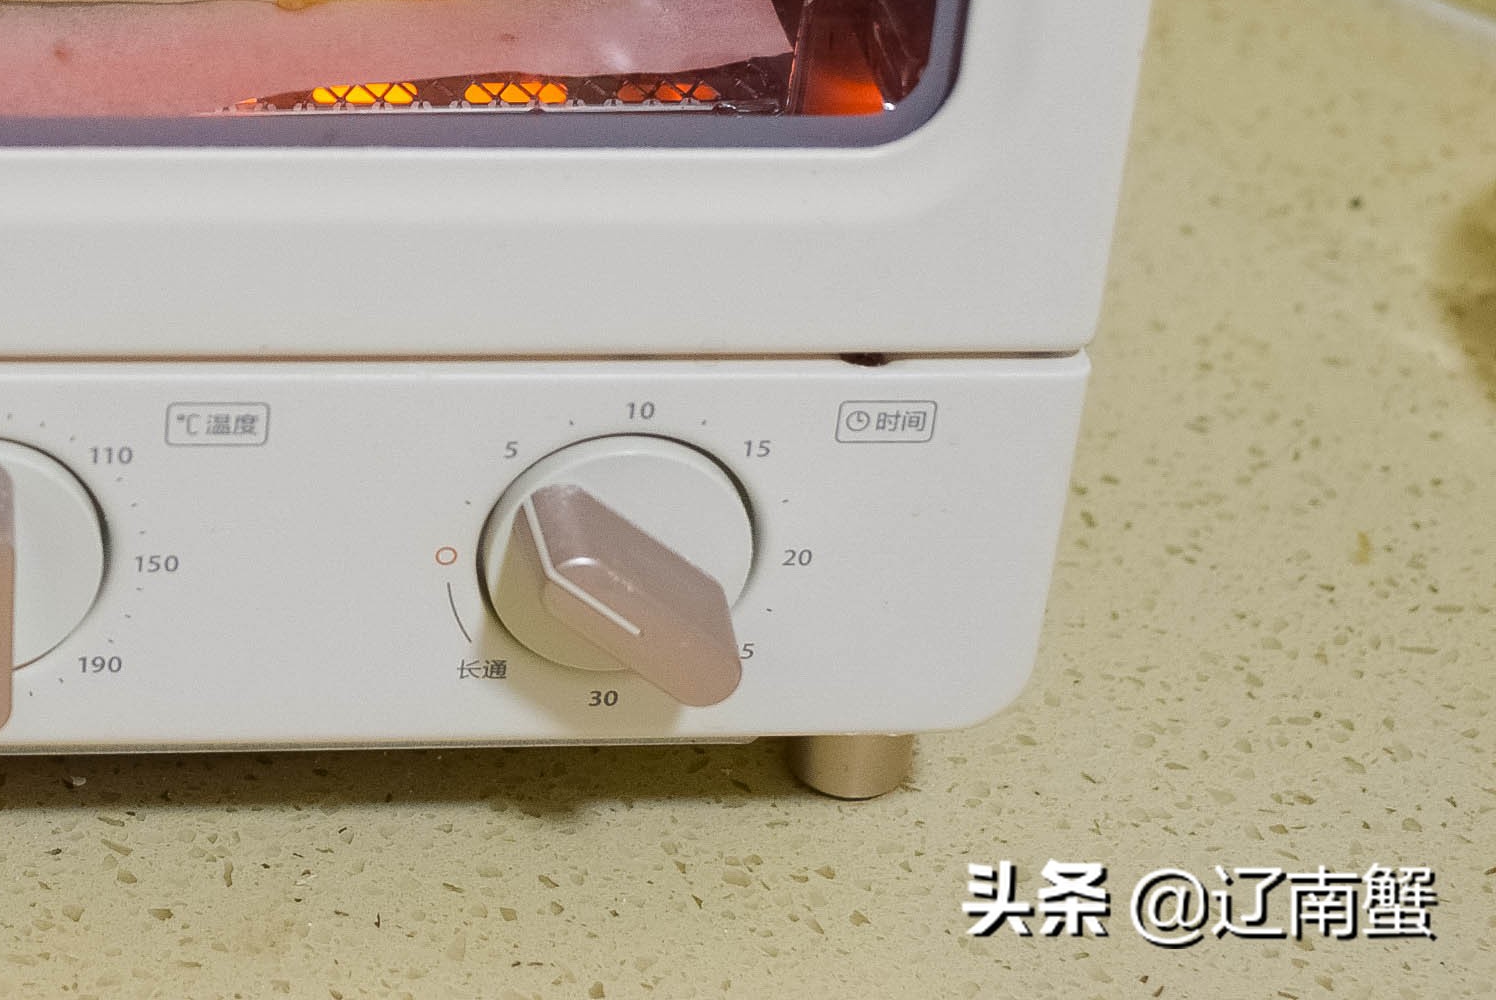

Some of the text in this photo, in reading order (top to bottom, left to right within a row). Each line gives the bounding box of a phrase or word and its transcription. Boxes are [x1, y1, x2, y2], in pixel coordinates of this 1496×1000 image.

[627, 401, 656, 420] 10
[874, 411, 928, 433] 时间
[89, 446, 134, 465] 110
[503, 440, 519, 459] 5
[743, 439, 771, 458] 15
[135, 554, 180, 573] 150
[781, 548, 813, 567] 20
[736, 642, 755, 660] 5
[78, 655, 123, 674] 190
[456, 658, 507, 681] 长通
[587, 690, 619, 707] 30
